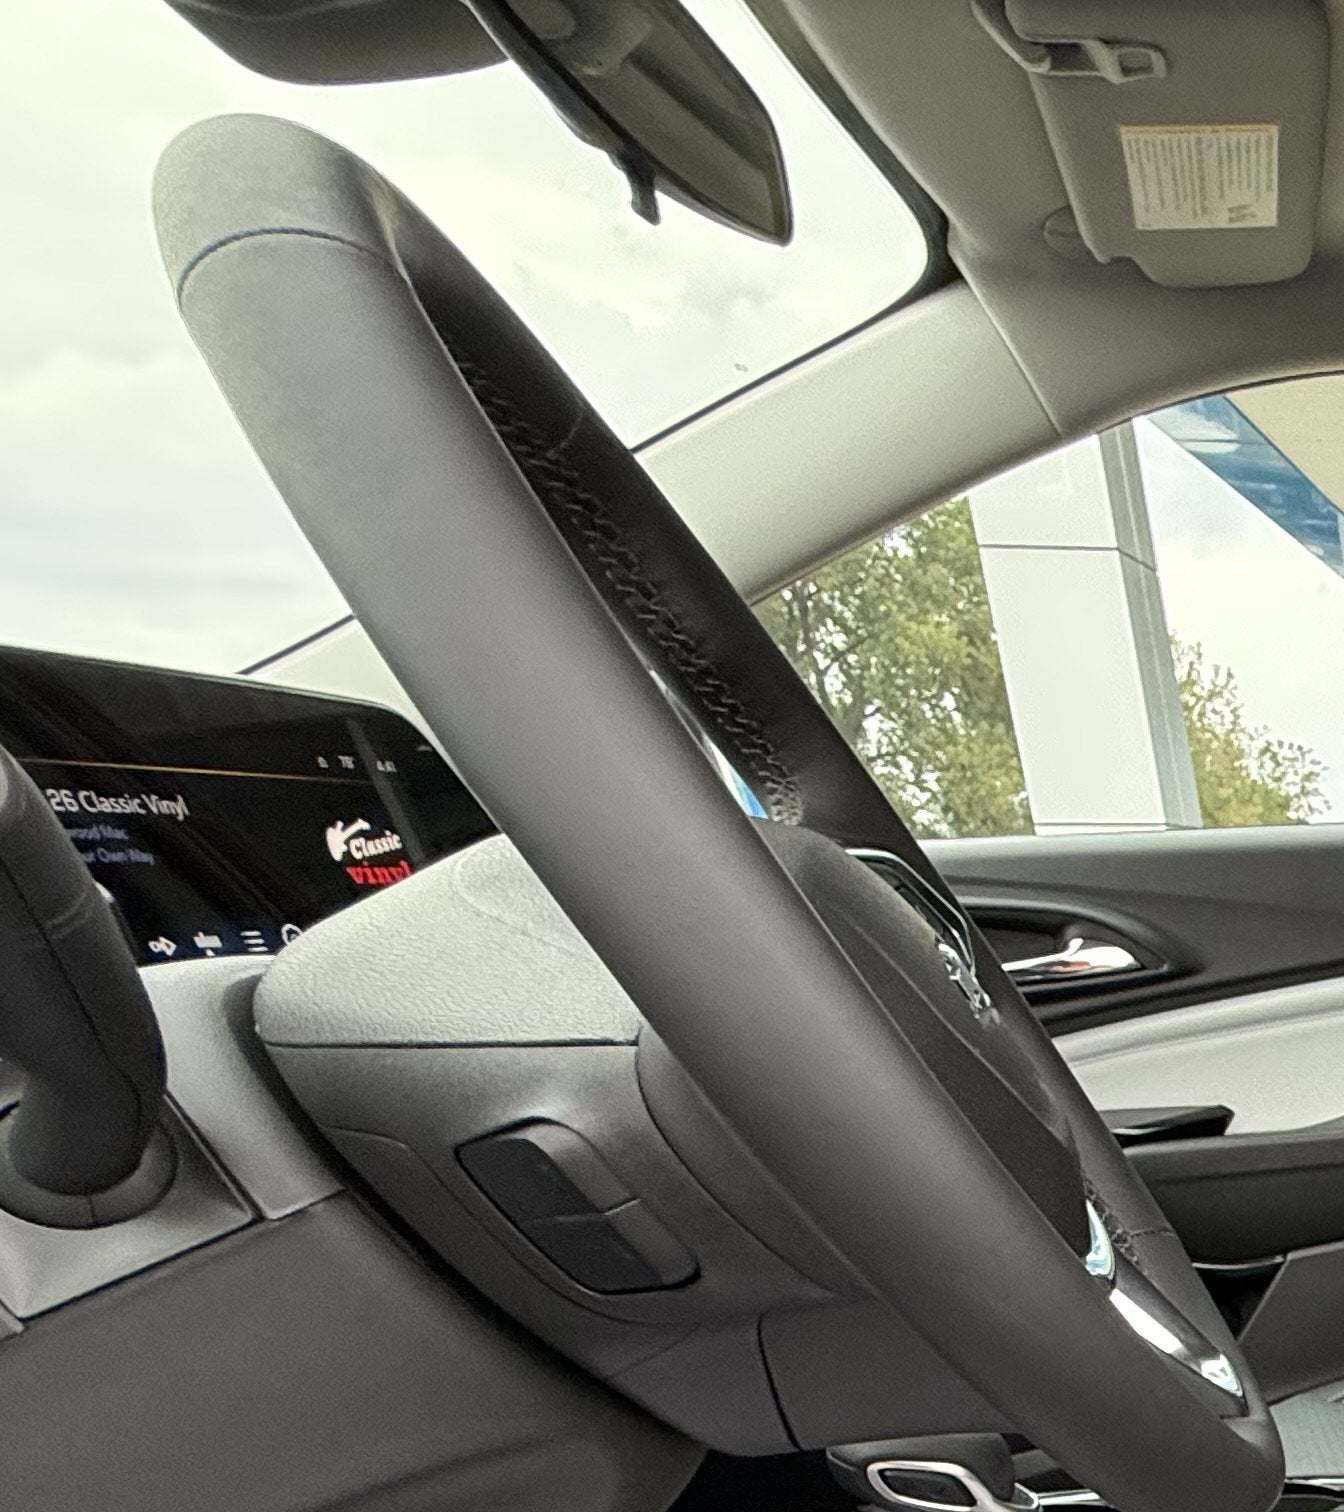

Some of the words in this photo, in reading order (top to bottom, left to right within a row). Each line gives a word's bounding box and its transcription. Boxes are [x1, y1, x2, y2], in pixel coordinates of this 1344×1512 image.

[78, 790, 147, 814] Classic
[141, 793, 190, 821] Vinyl
[349, 830, 403, 859] Classic
